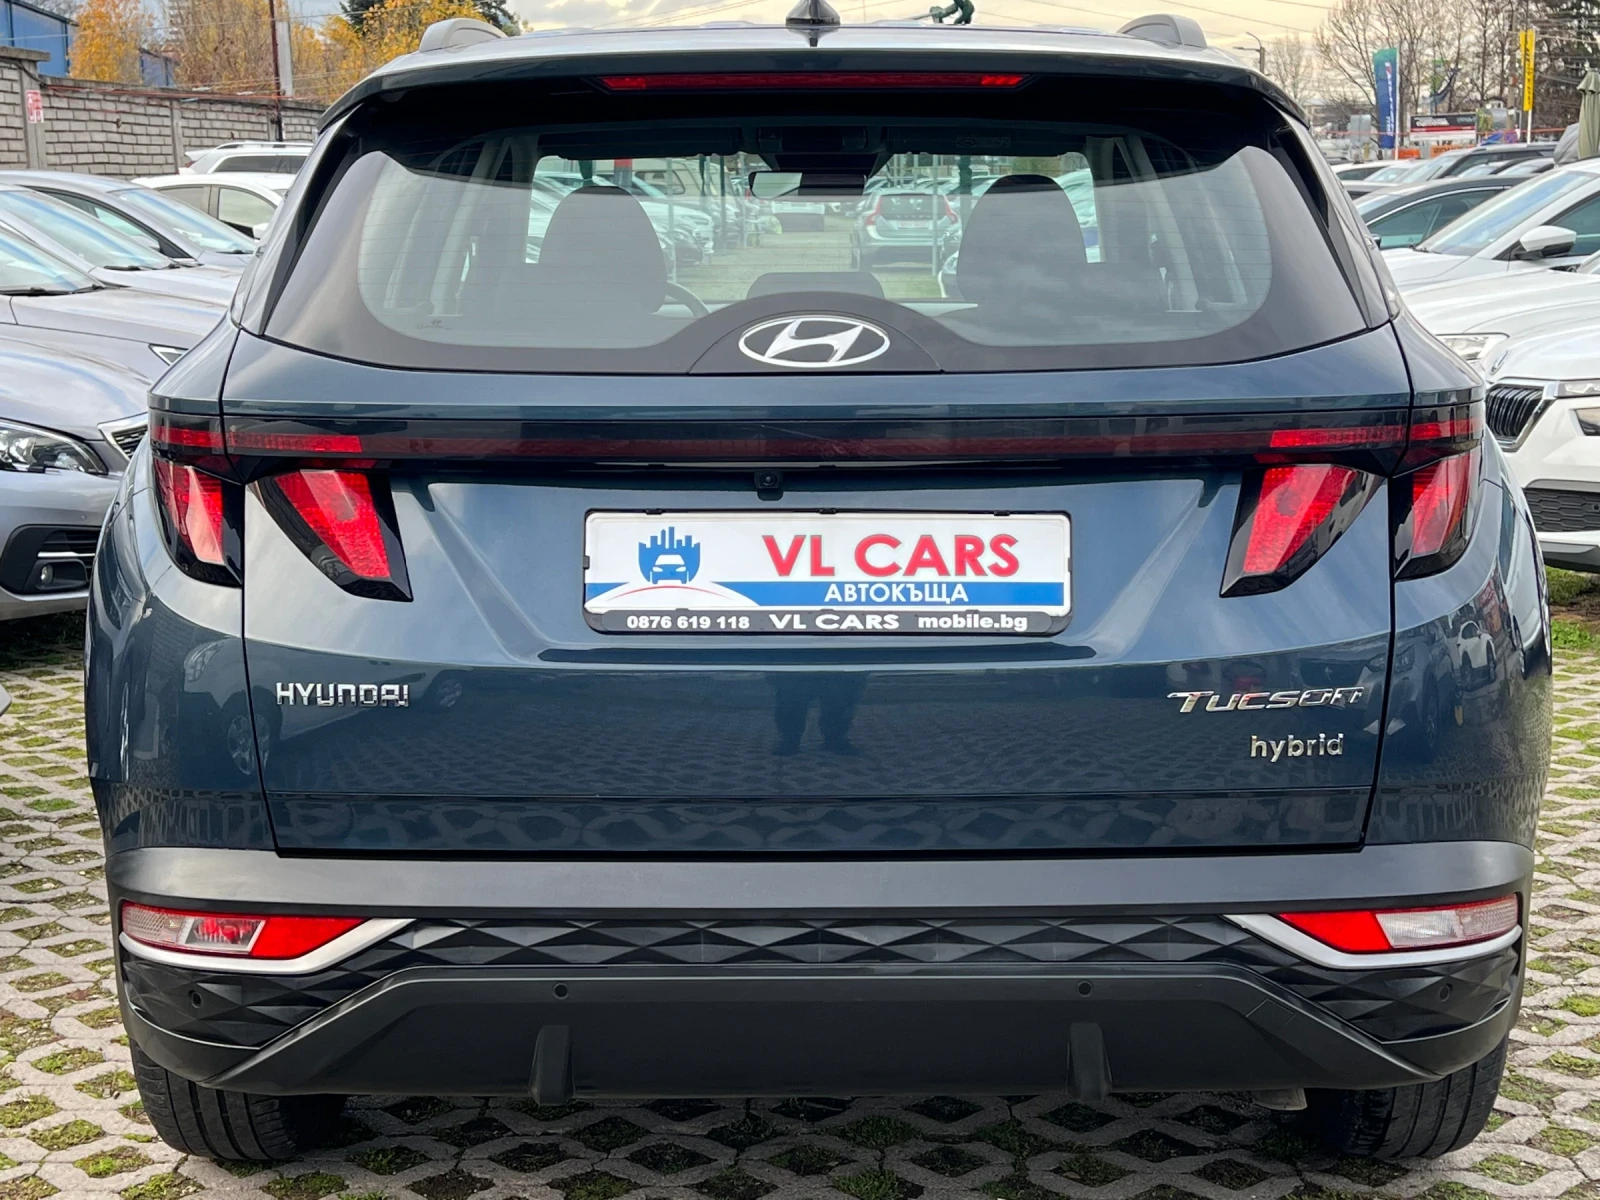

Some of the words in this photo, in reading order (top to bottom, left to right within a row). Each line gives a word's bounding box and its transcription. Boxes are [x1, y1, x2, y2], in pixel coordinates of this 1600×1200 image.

[761, 535, 836, 577] VL
[854, 534, 1020, 577] CARS
[823, 583, 969, 604] АВТОКЪЩА
[626, 615, 672, 629] 0876
[676, 615, 711, 629] 619
[716, 615, 750, 629] 118
[769, 614, 807, 629] VL
[815, 613, 900, 629] CARS
[917, 613, 1028, 632] mobile.bg
[275, 682, 409, 707] HYUNDAI
[1166, 686, 1365, 713] TUCSON
[1250, 733, 1344, 763] hybrid
